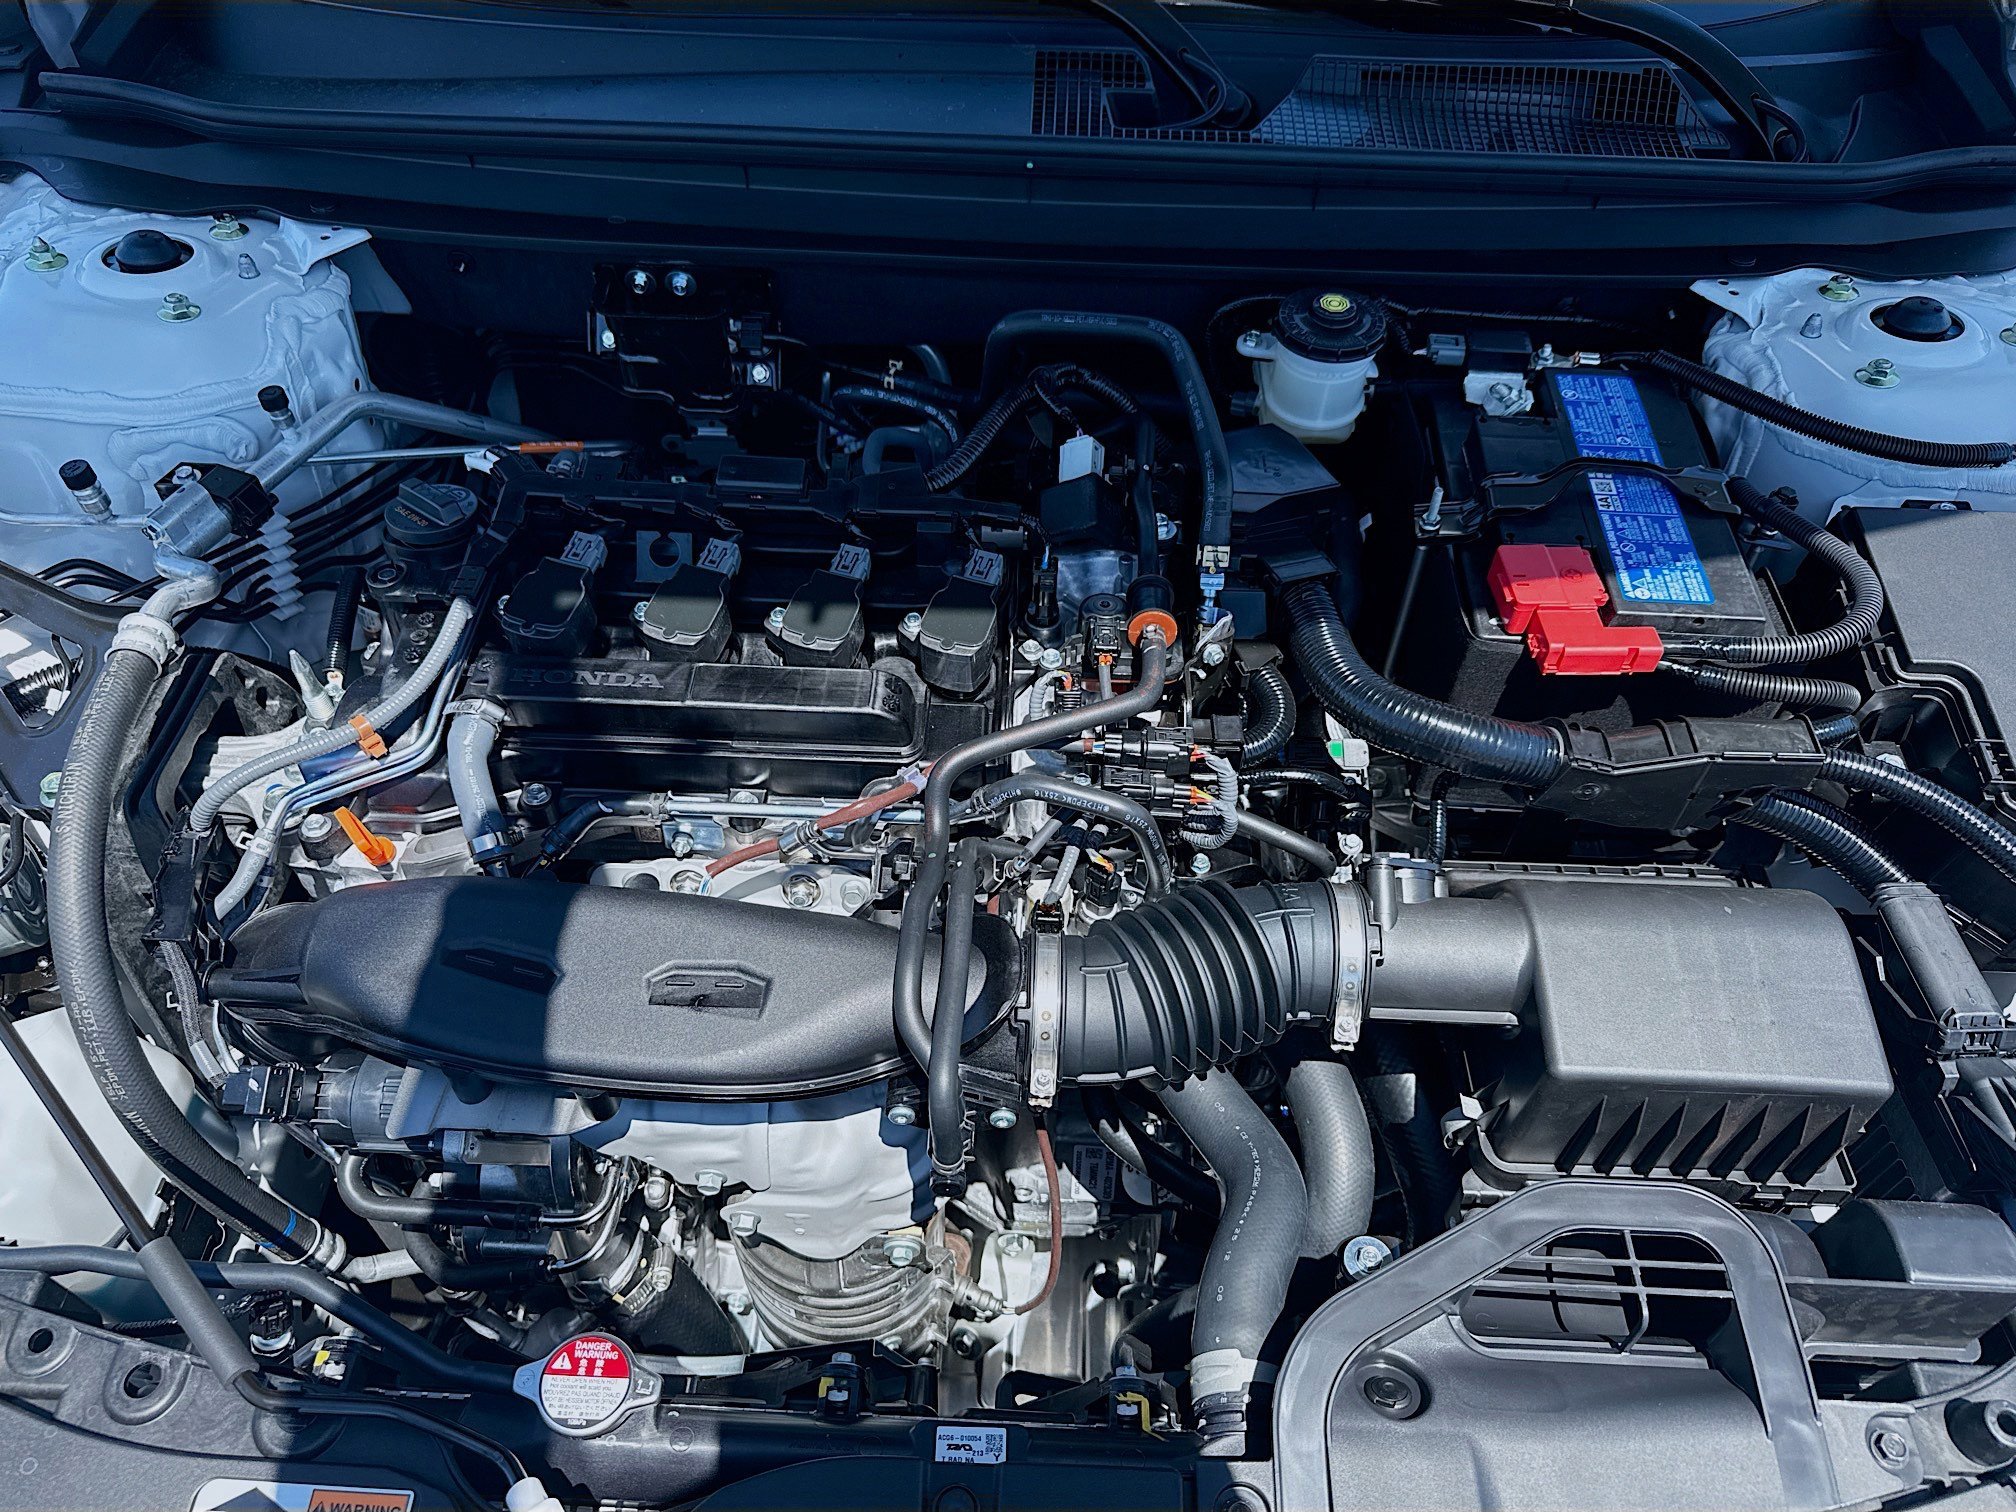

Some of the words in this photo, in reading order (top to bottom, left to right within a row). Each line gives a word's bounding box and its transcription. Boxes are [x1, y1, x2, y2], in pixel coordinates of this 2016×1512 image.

[510, 668, 664, 688] HONDA
[576, 1340, 612, 1351] DANGER
[574, 1350, 618, 1360] WARNUNG
[993, 1453, 1001, 1462] Y
